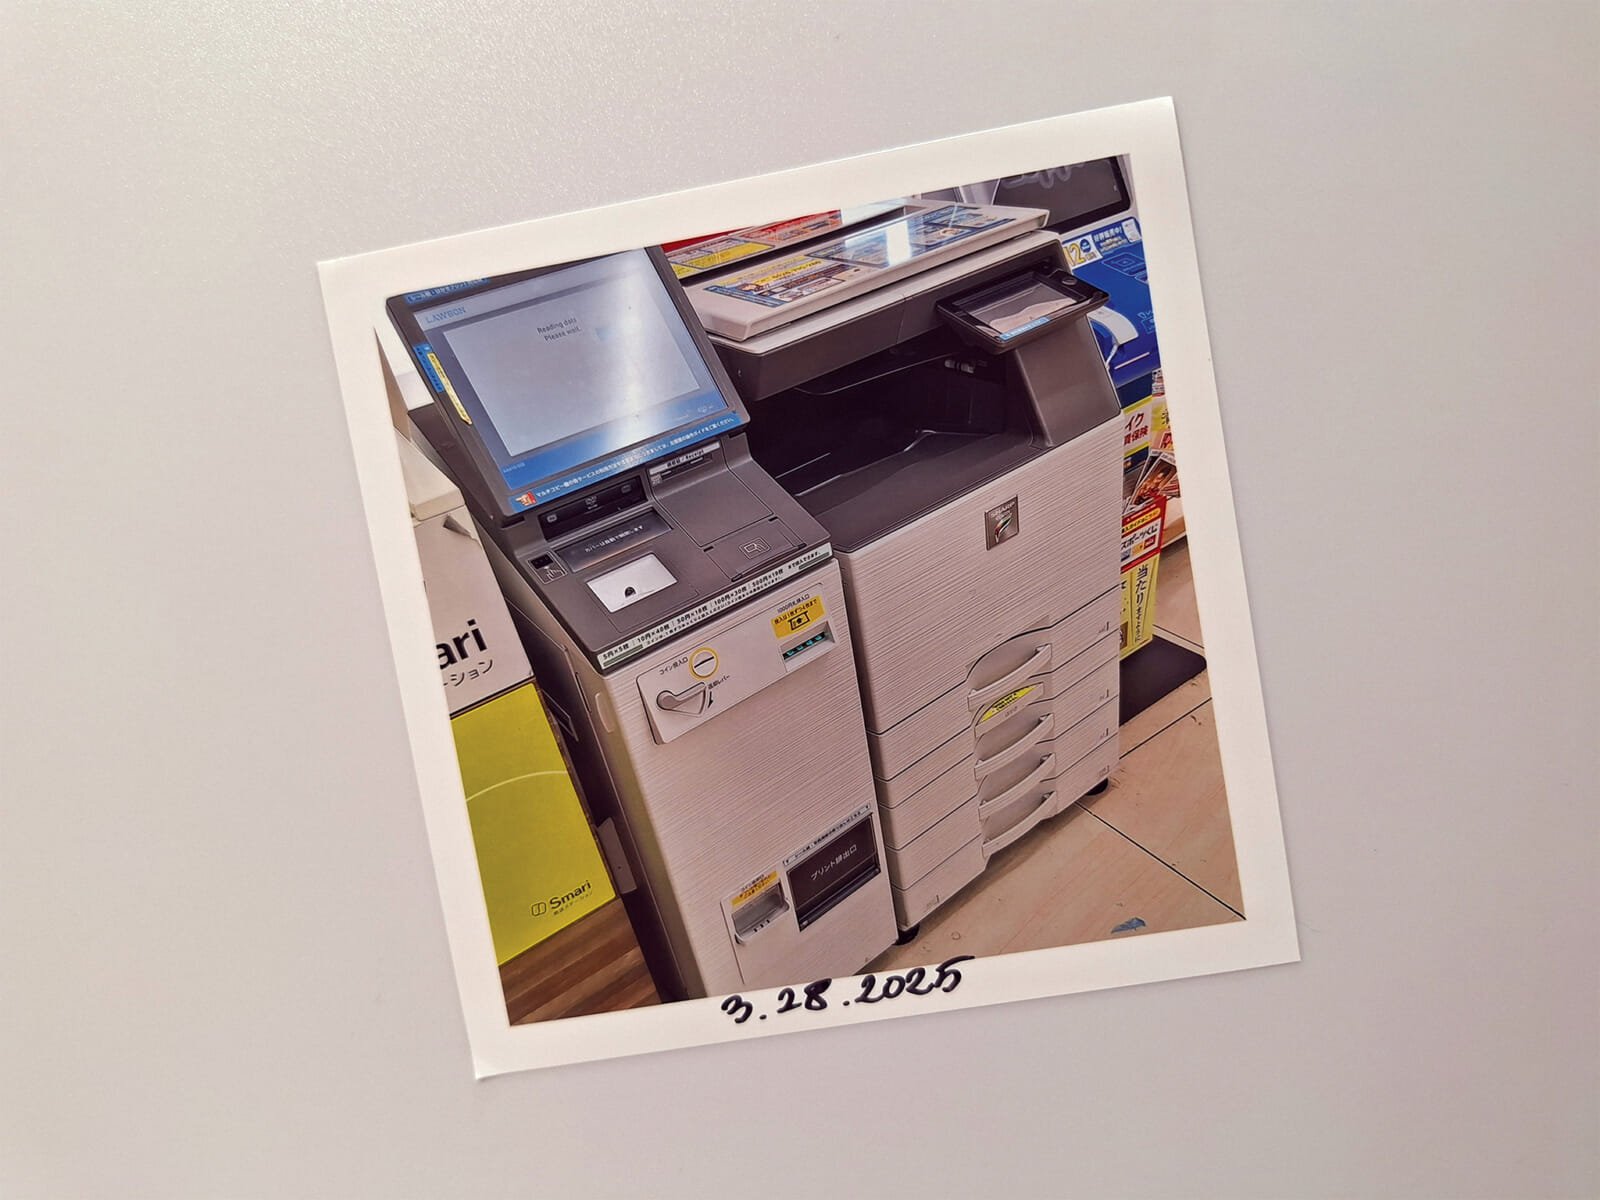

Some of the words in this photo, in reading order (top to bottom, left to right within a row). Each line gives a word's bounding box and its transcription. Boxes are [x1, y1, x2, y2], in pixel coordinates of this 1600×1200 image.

[537, 321, 564, 335] Reading
[544, 331, 567, 342] Please
[436, 619, 487, 669] ari
[810, 843, 858, 881] プリント排出口
[550, 879, 591, 910] Smari
